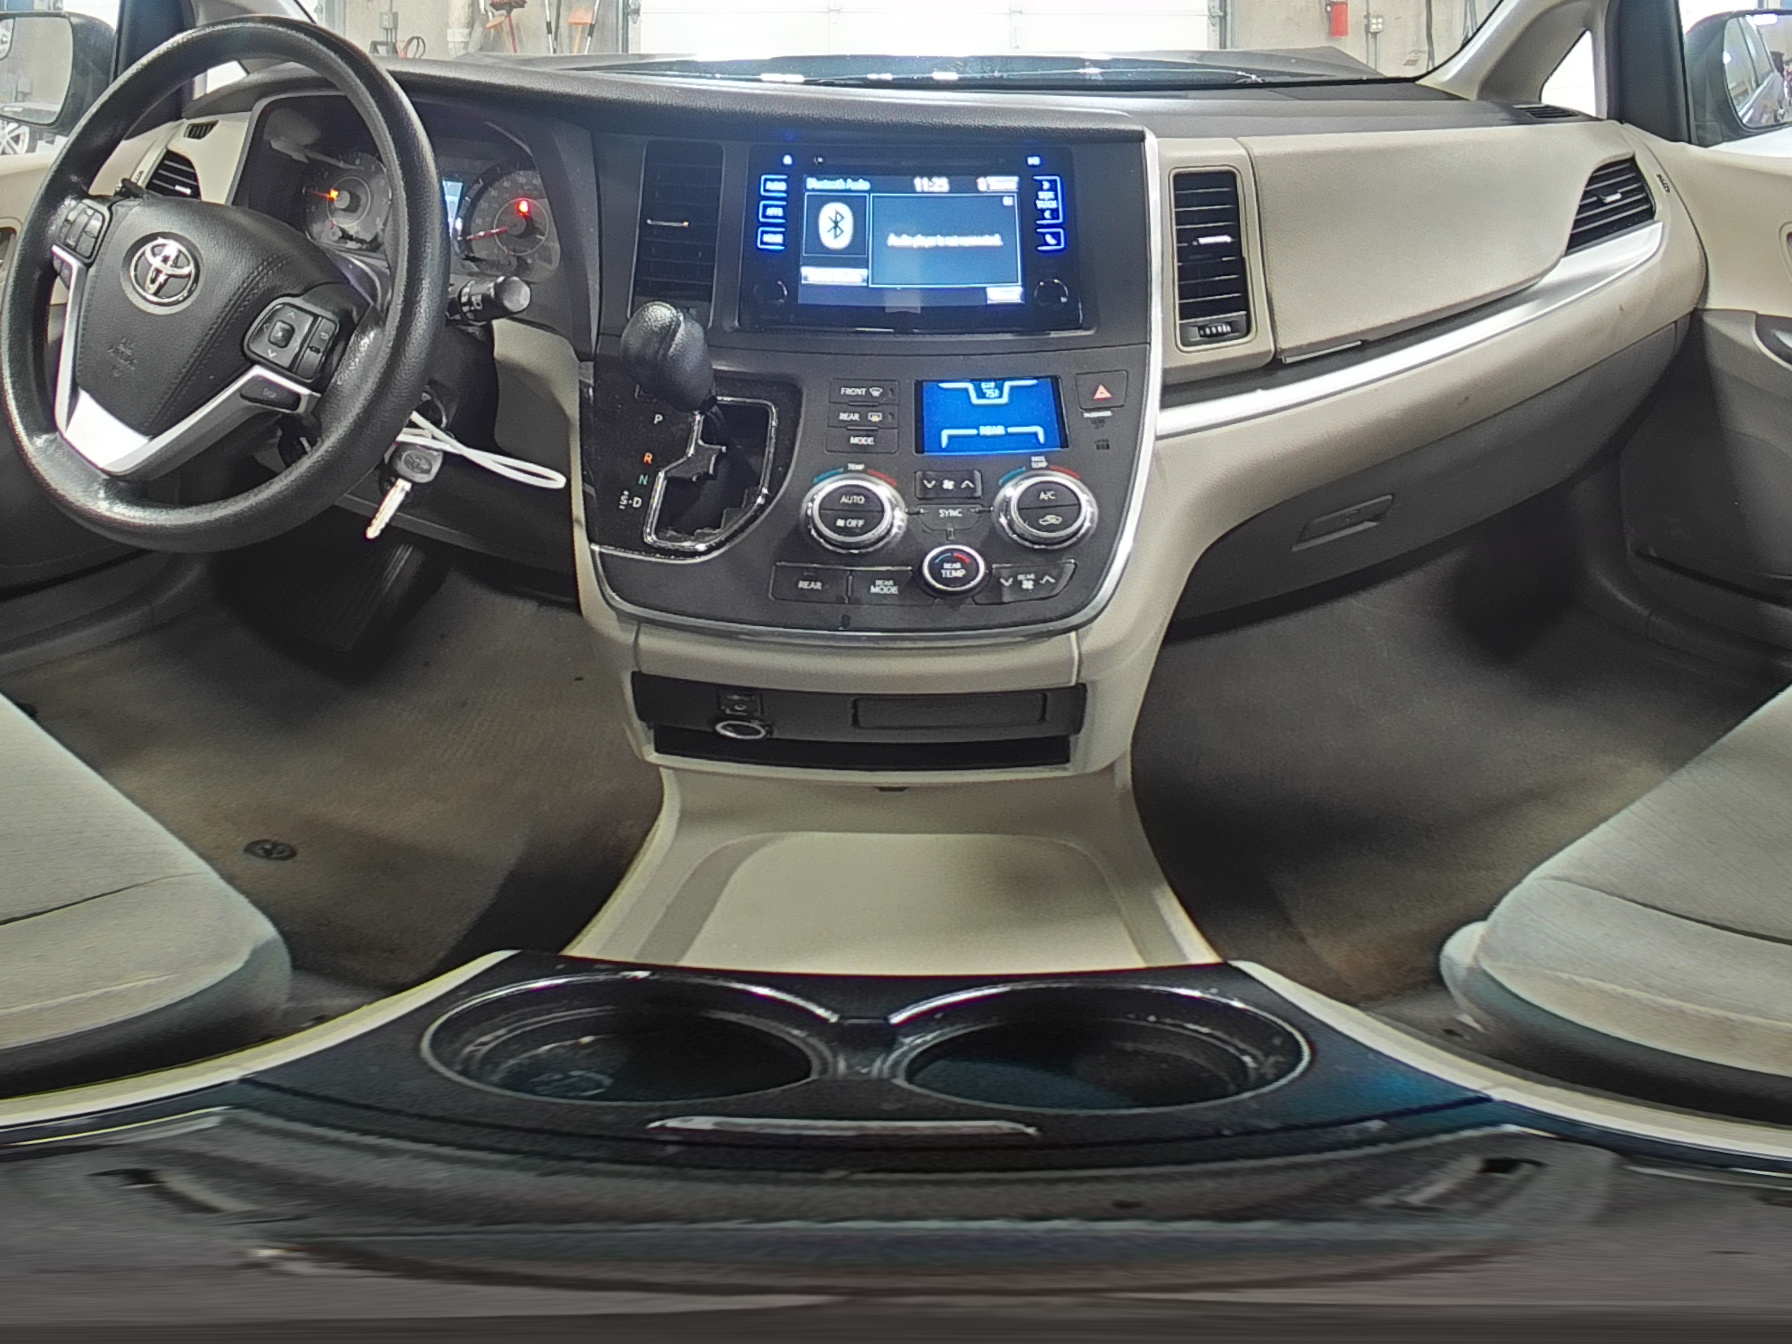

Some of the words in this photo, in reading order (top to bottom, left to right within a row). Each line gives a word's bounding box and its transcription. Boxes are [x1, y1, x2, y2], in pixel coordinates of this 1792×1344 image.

[840, 387, 867, 396] FRONT
[653, 413, 664, 425] P
[839, 412, 860, 421] REAR
[849, 436, 875, 445] MODE
[643, 452, 653, 464] R
[638, 475, 648, 486] N
[839, 495, 866, 504] AUTO
[1039, 490, 1056, 501] A/C
[632, 497, 642, 508] D
[938, 508, 963, 518] SYNC
[846, 518, 865, 528] OFF
[940, 569, 967, 578] TEMP
[797, 580, 823, 591] REAR
[869, 585, 900, 595] MODE
